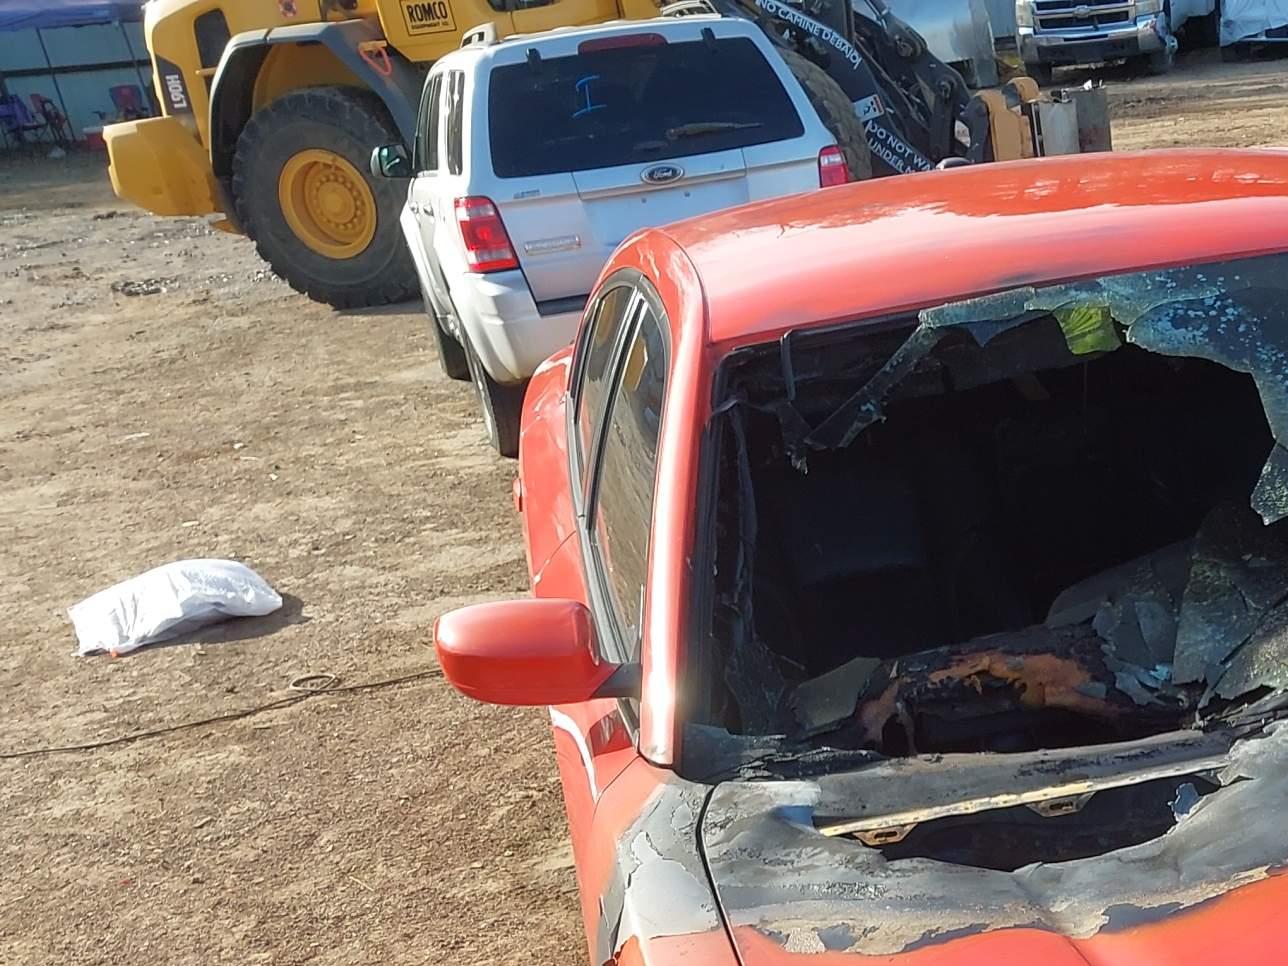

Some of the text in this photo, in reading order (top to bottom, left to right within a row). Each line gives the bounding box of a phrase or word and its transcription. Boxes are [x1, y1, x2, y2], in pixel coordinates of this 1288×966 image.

[406, 1, 448, 23] ROMCO
[778, 8, 822, 37] CAMINE
[165, 74, 188, 109] L90H
[886, 133, 913, 158] NOT
